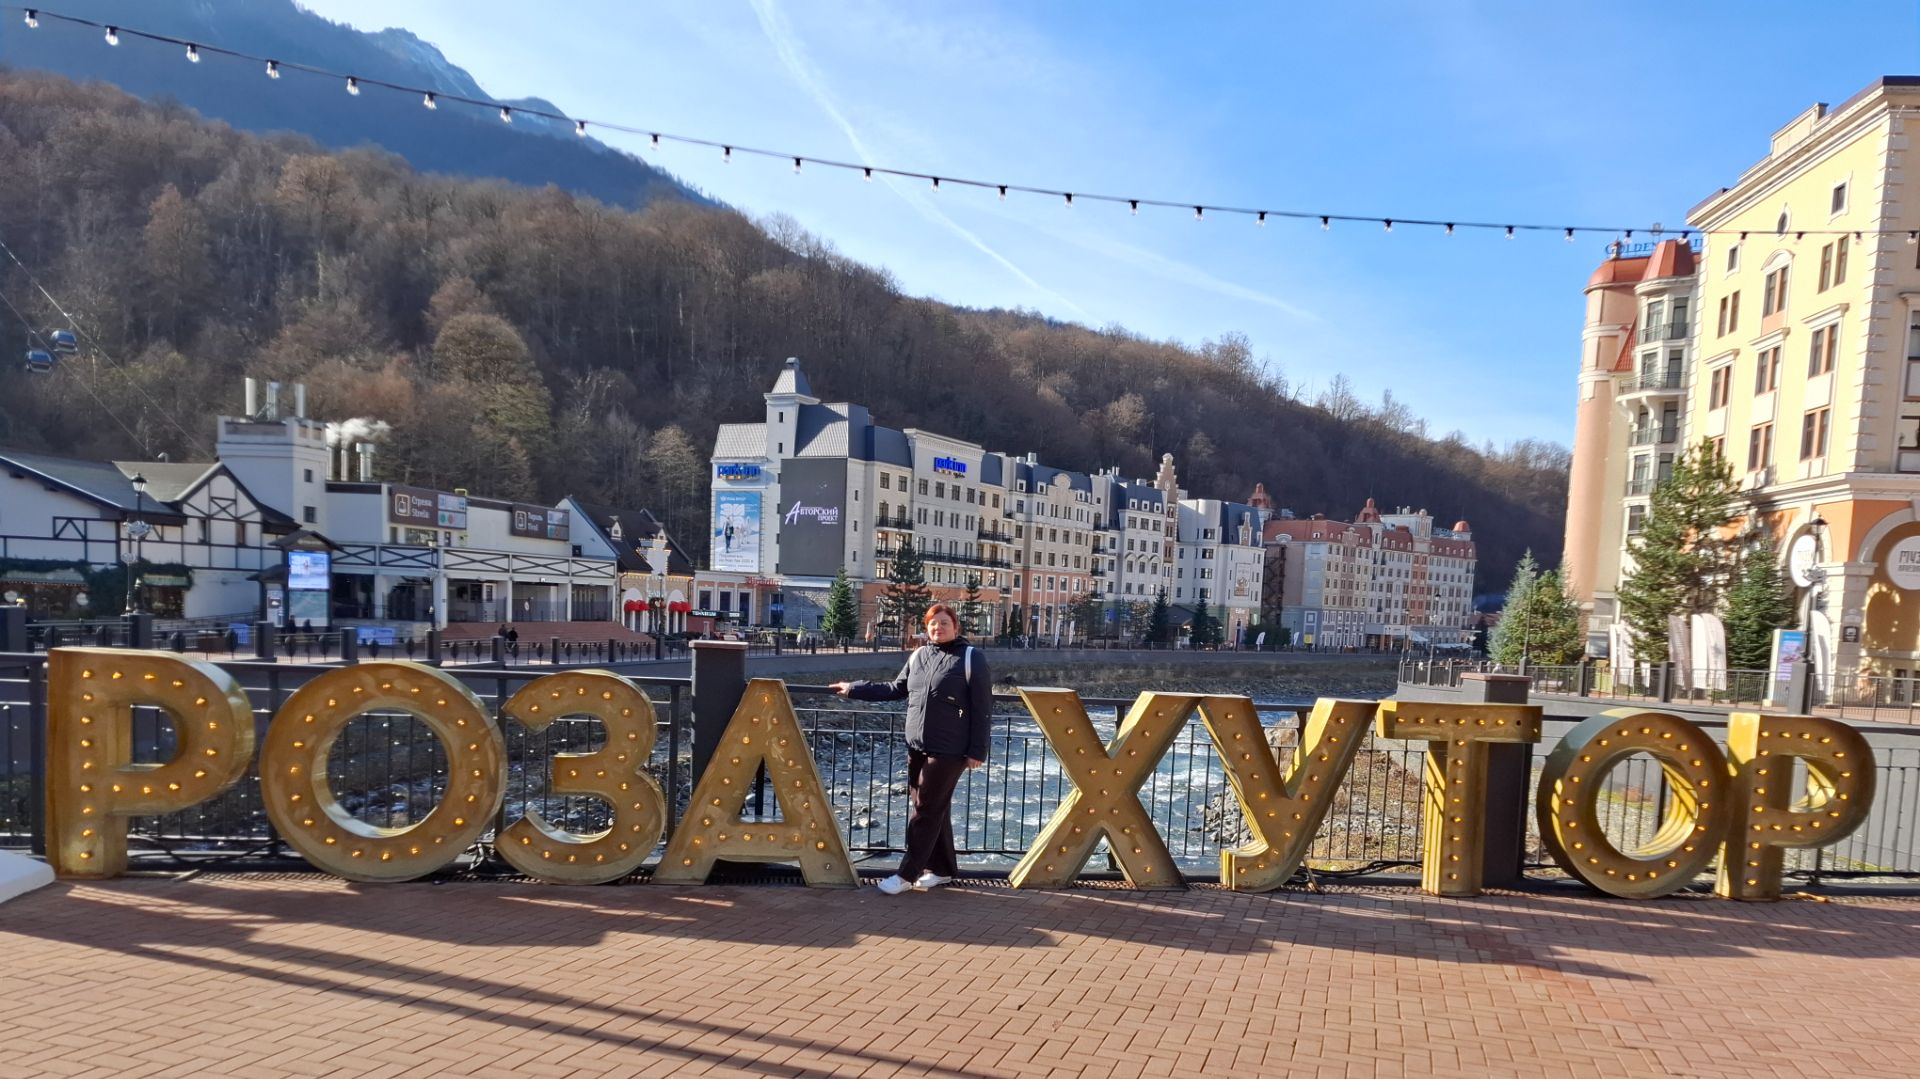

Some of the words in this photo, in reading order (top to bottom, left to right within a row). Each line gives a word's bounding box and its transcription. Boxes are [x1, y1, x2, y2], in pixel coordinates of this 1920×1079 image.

[1605, 241, 1657, 255] GLDEN
[46, 646, 860, 890] РОЗА
[1009, 686, 1877, 901] ХУТОР
